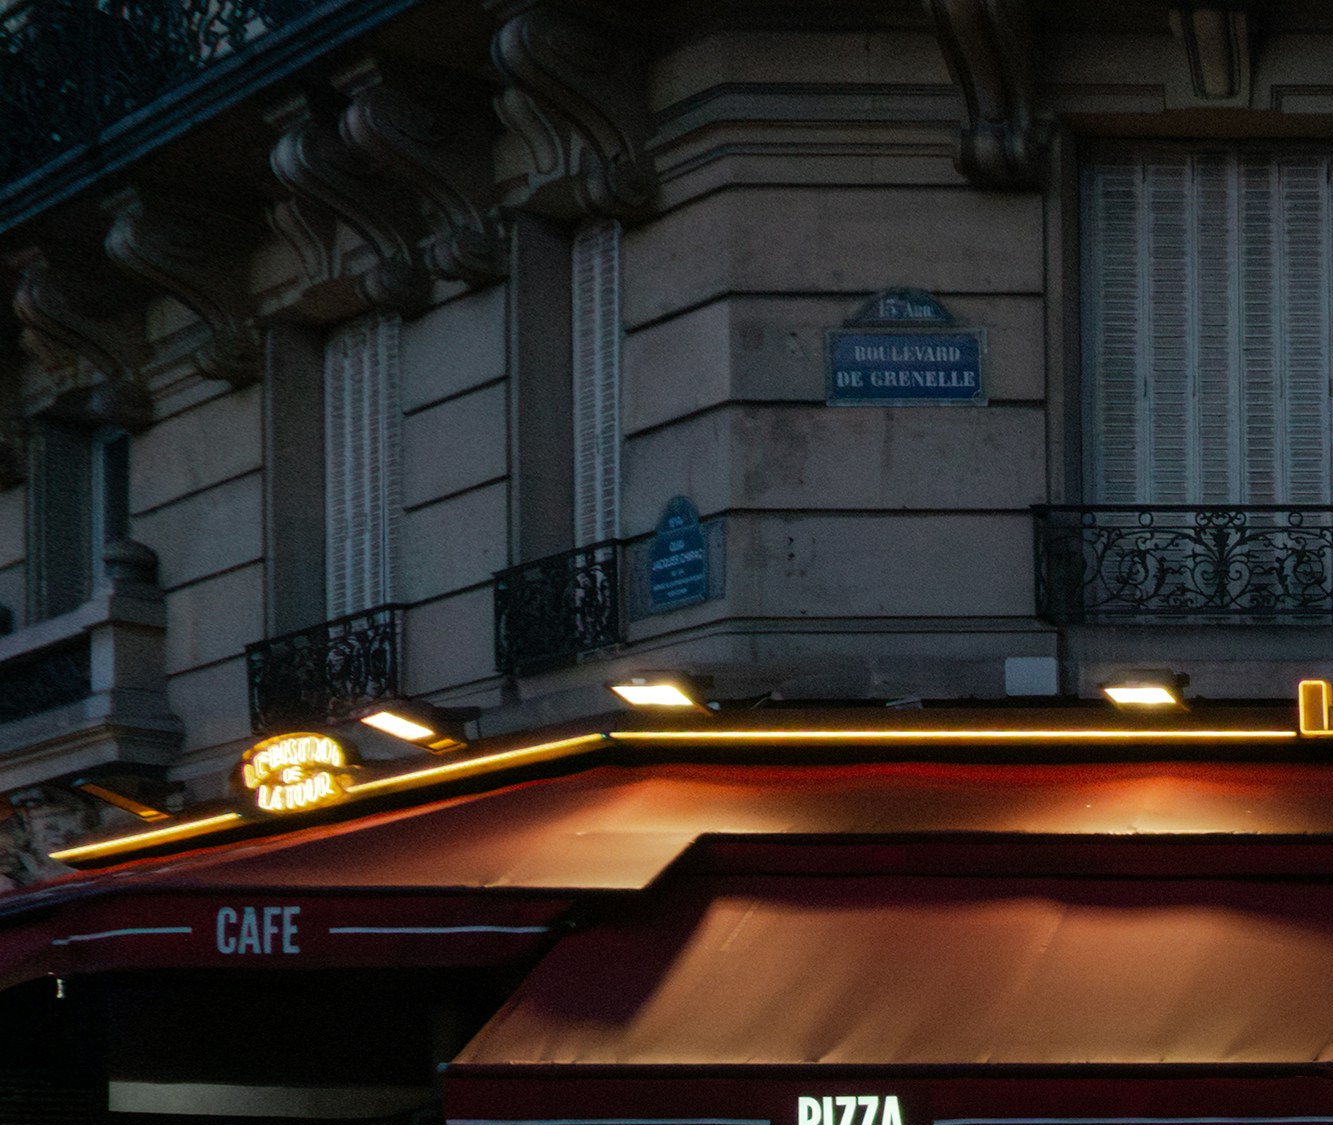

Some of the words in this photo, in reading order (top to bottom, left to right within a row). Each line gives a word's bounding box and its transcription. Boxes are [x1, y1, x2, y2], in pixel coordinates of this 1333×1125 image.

[854, 345, 961, 362] BOULEVARD
[836, 370, 864, 387] DE
[870, 370, 976, 388] GRENELLE
[215, 906, 300, 955] CAFE
